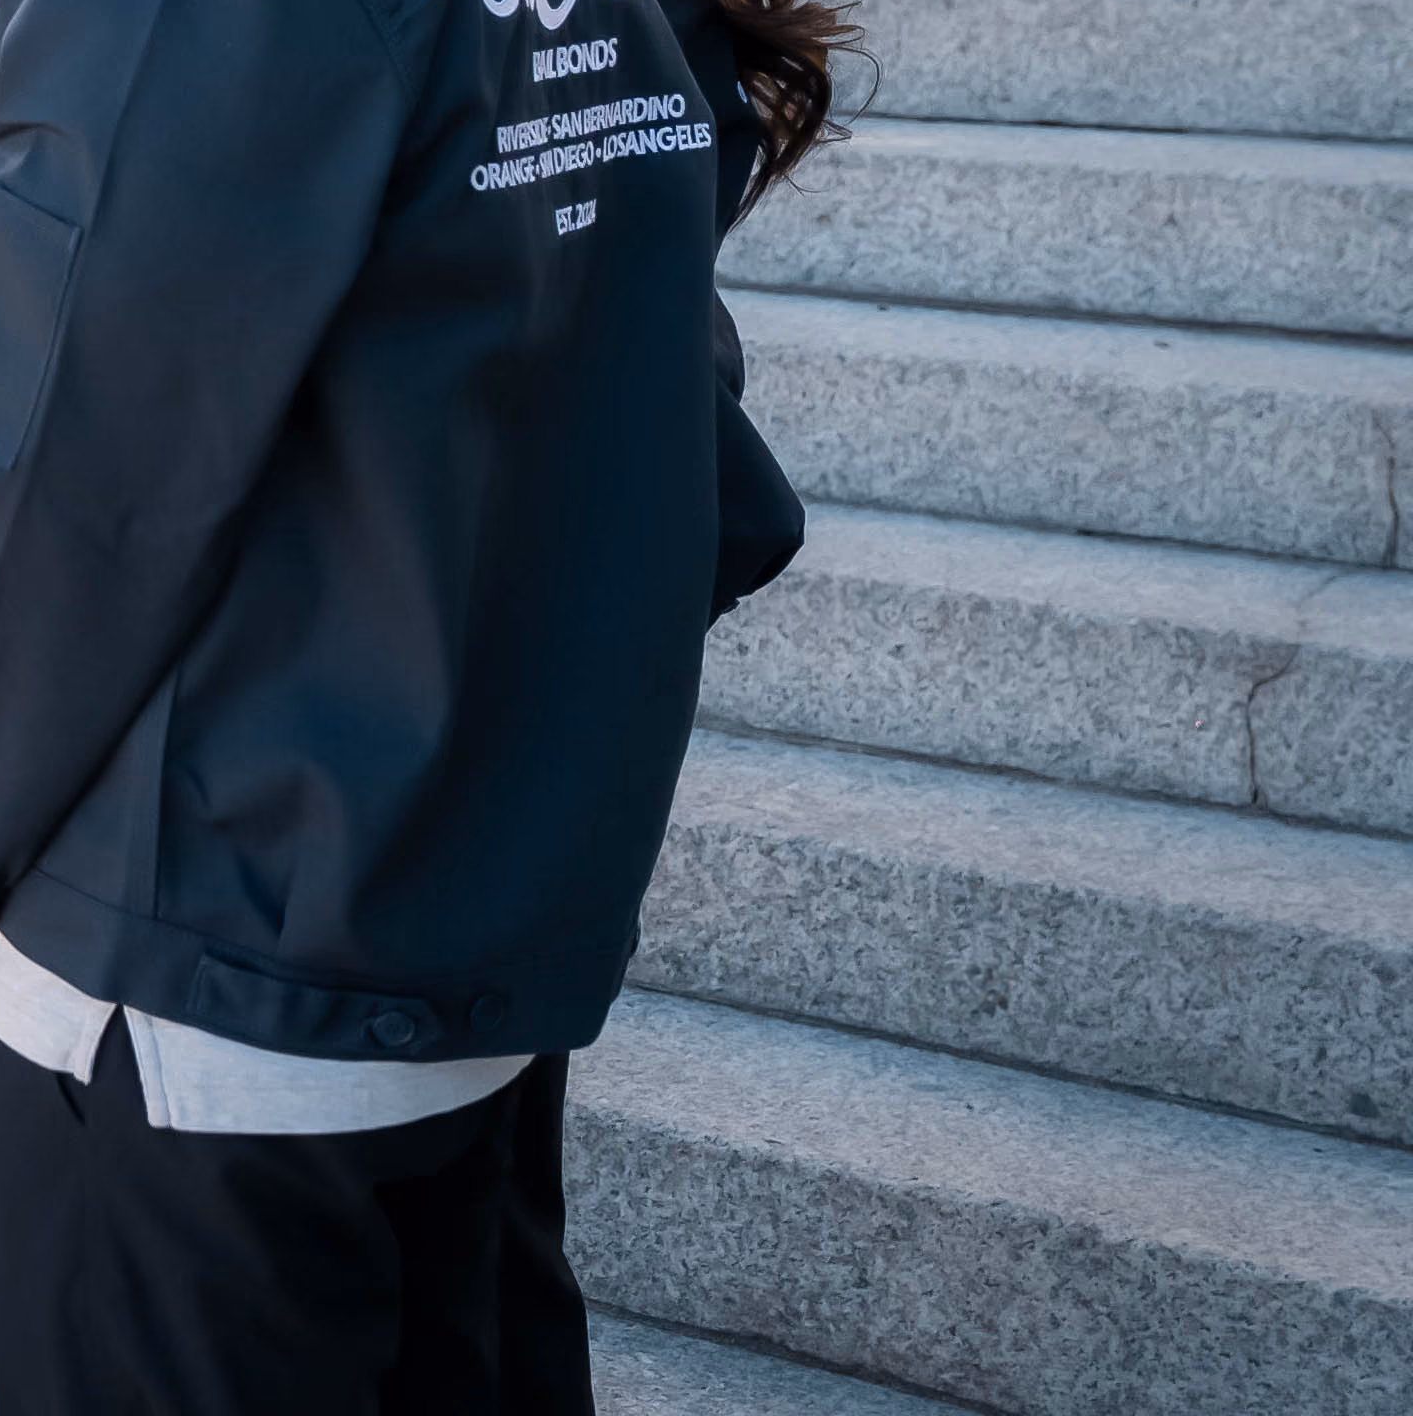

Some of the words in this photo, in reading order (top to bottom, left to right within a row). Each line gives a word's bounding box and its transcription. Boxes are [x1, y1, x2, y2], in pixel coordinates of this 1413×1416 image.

[556, 37, 618, 78] BONDS
[552, 110, 583, 140] SAN
[583, 93, 686, 135] BERNARDINO
[471, 156, 535, 191] ORANGE
[553, 141, 594, 175] DIEGO
[603, 133, 628, 162] LOS
[625, 123, 712, 158] ANGELES
